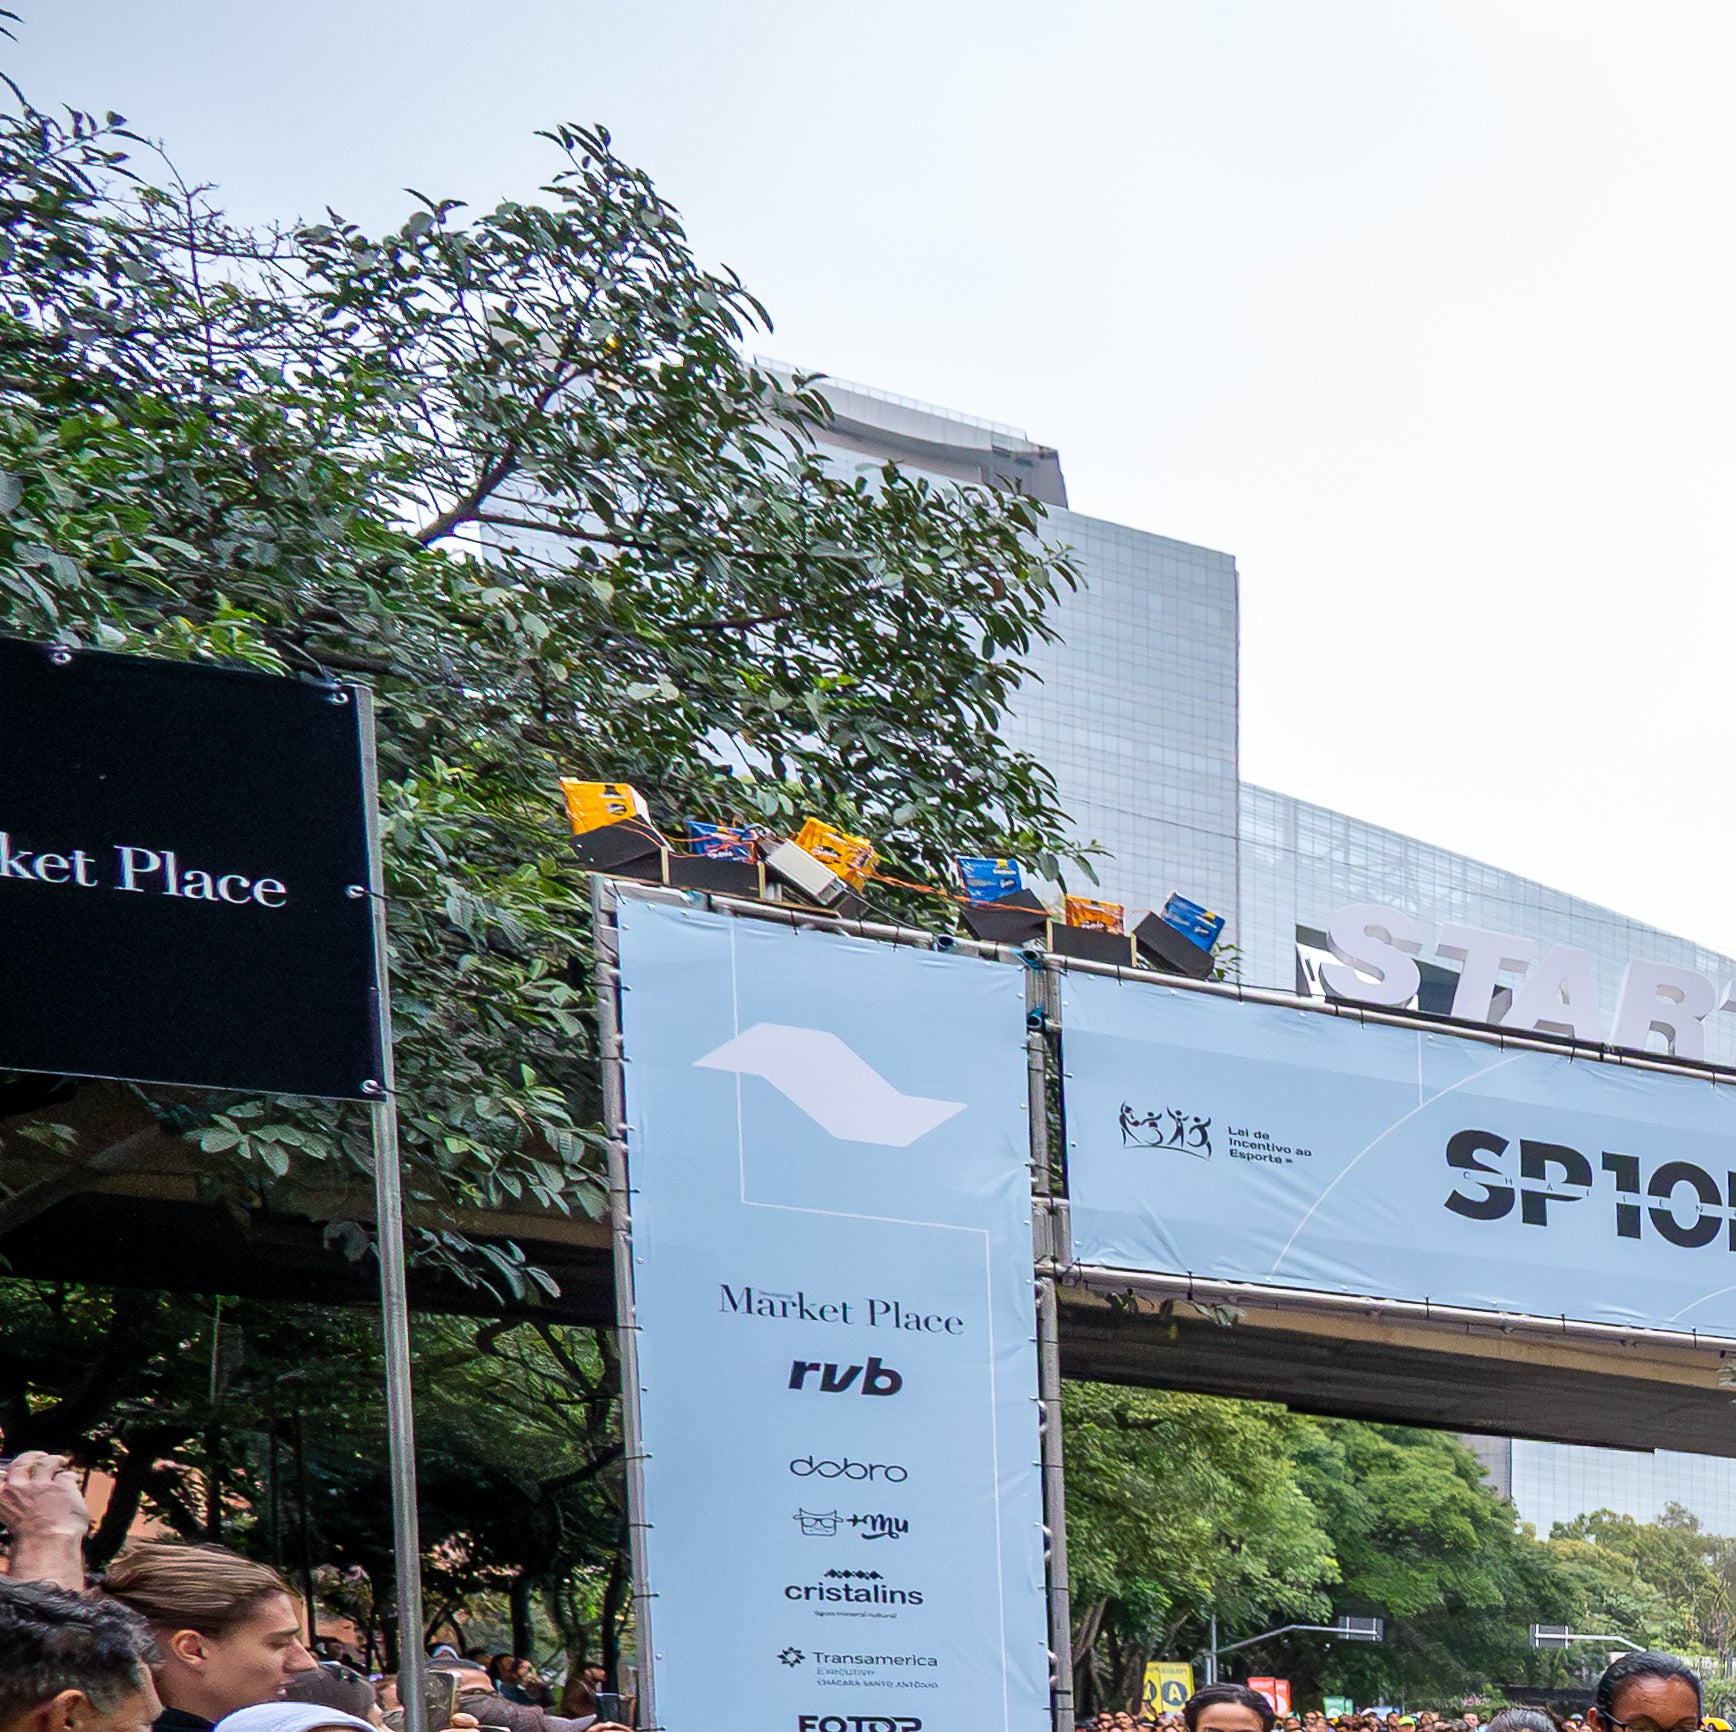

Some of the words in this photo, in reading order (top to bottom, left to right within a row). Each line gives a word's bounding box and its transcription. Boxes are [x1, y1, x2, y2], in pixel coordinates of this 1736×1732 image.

[113, 845, 288, 907] Place
[1253, 1130, 1271, 1140] de
[1229, 1148, 1283, 1164] Esporte
[719, 1283, 854, 1326] Market
[866, 1298, 965, 1335] Place
[788, 1356, 903, 1397] rvb
[790, 1455, 908, 1483] dobro
[784, 1581, 924, 1605] cristalins
[812, 1650, 938, 1668] Transamerica
